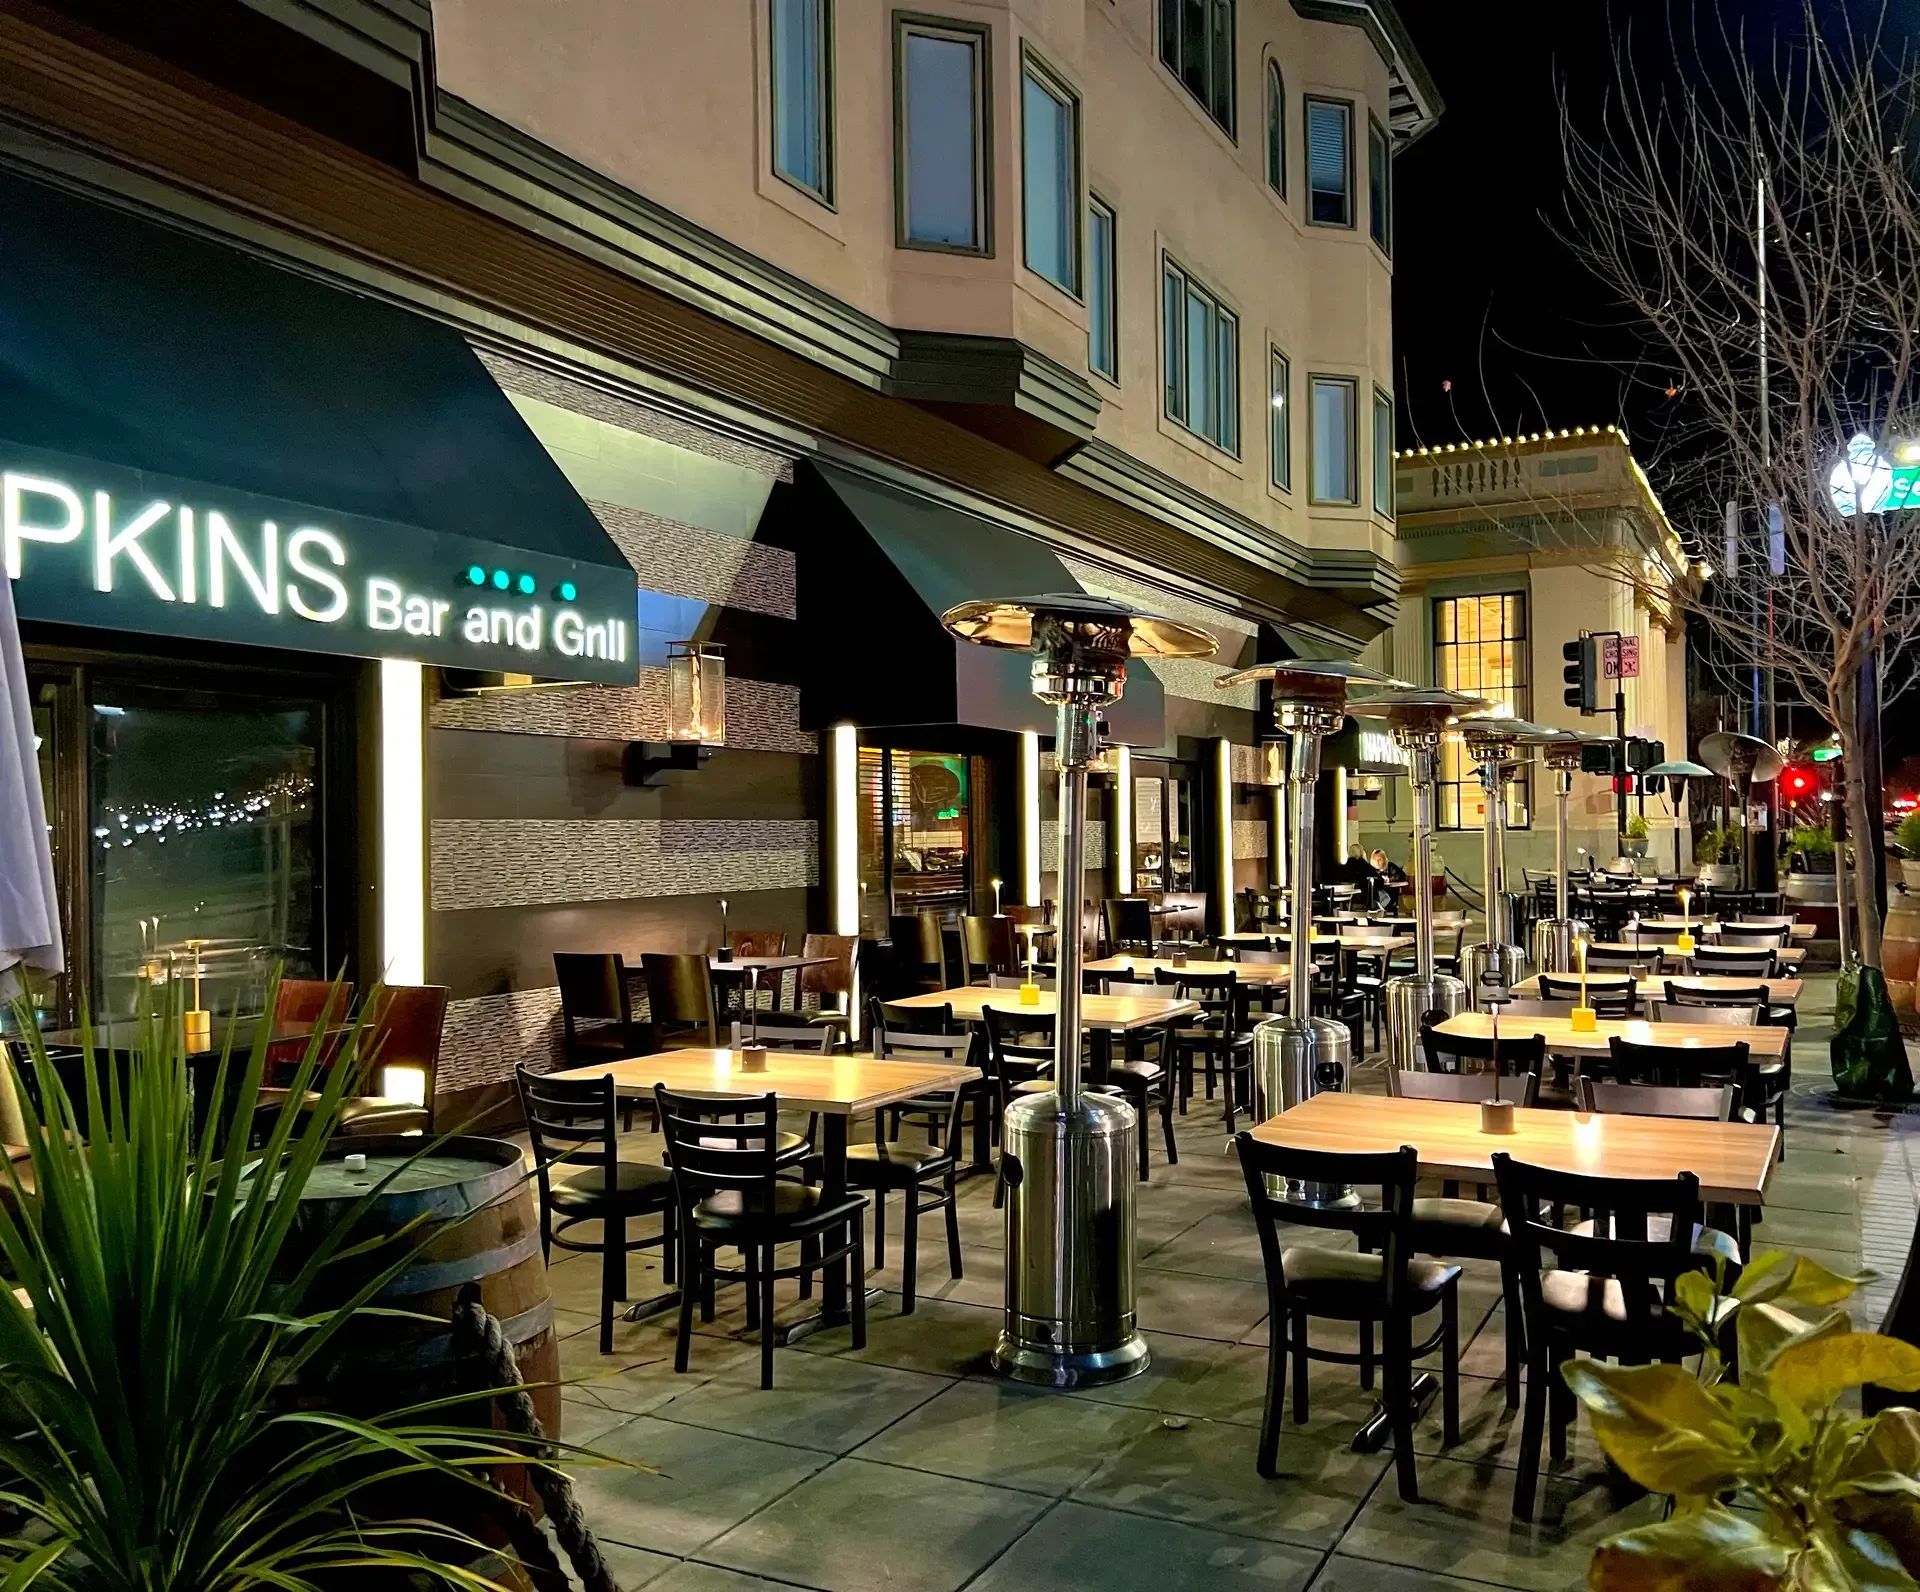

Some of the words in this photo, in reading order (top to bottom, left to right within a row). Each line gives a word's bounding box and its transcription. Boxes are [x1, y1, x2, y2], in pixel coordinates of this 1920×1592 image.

[367, 577, 449, 637] Bar
[464, 605, 541, 650] and
[554, 610, 625, 662] Grill
